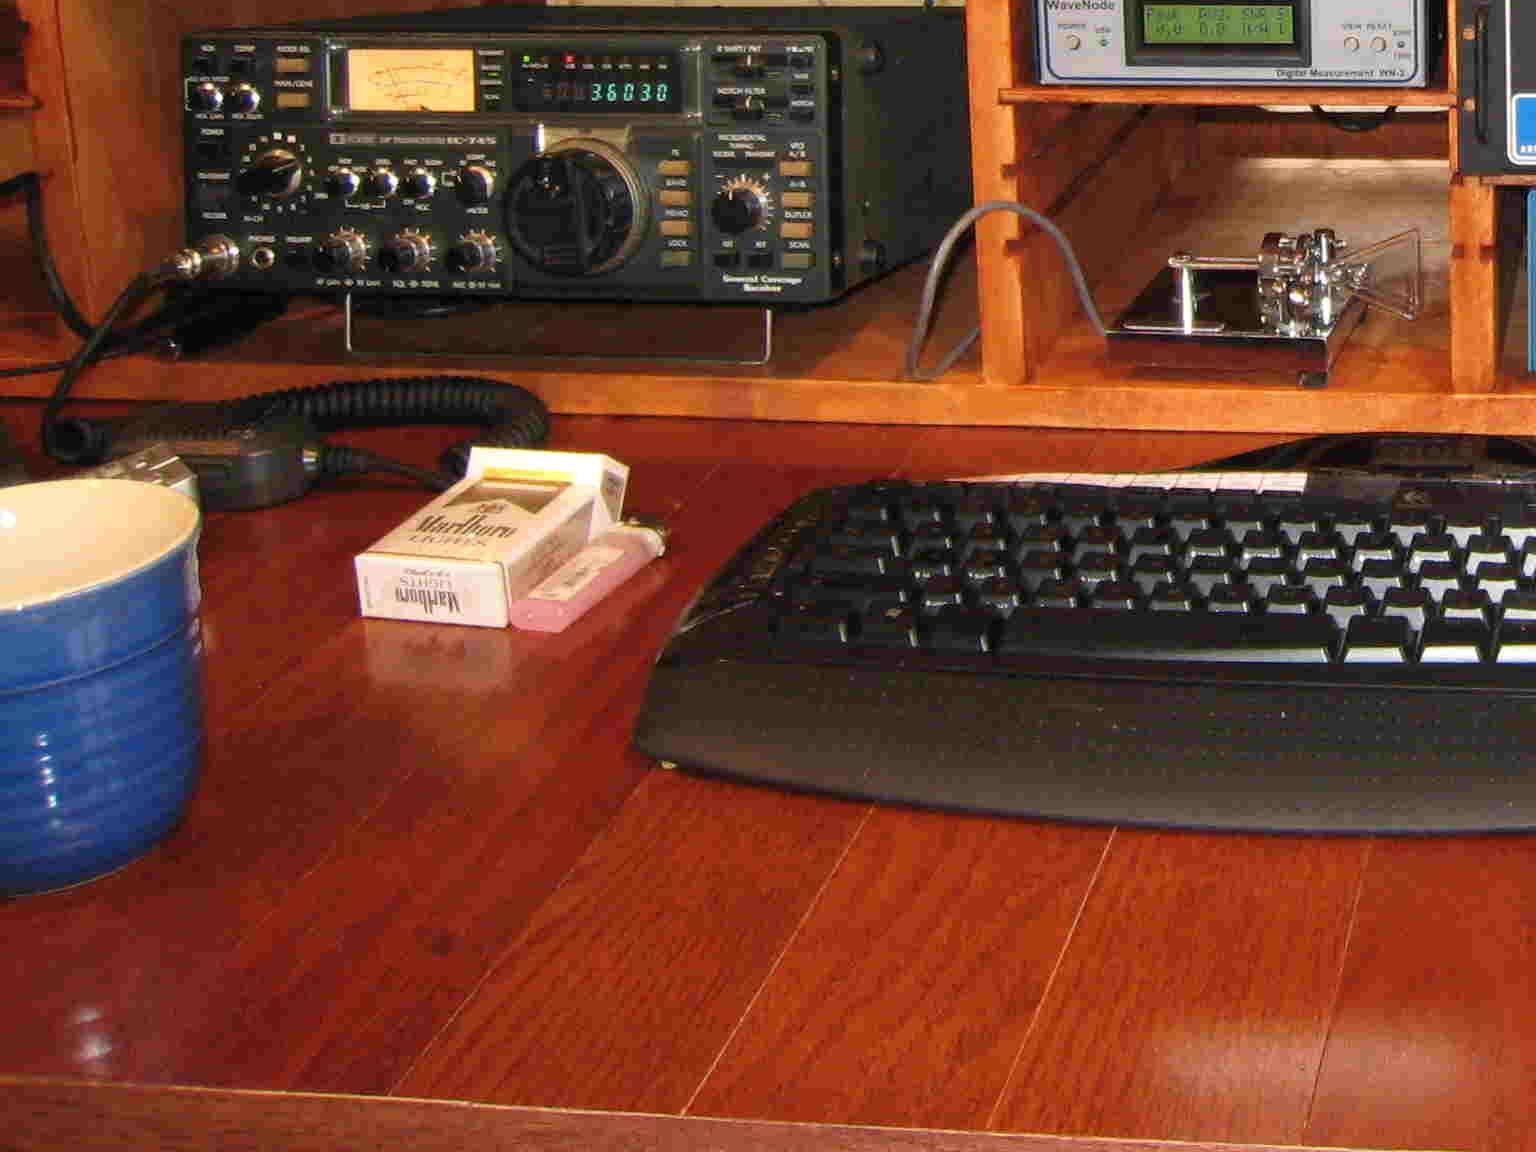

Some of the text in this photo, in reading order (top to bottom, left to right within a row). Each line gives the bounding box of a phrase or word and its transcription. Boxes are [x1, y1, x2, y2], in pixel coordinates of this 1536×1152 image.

[1046, 0, 1116, 11] WaveNode
[1276, 69, 1307, 79] Digital
[1309, 68, 1374, 78] Measurement
[667, 239, 689, 248] LOCK
[788, 240, 811, 249] SCAN
[416, 514, 518, 539] Marlboro
